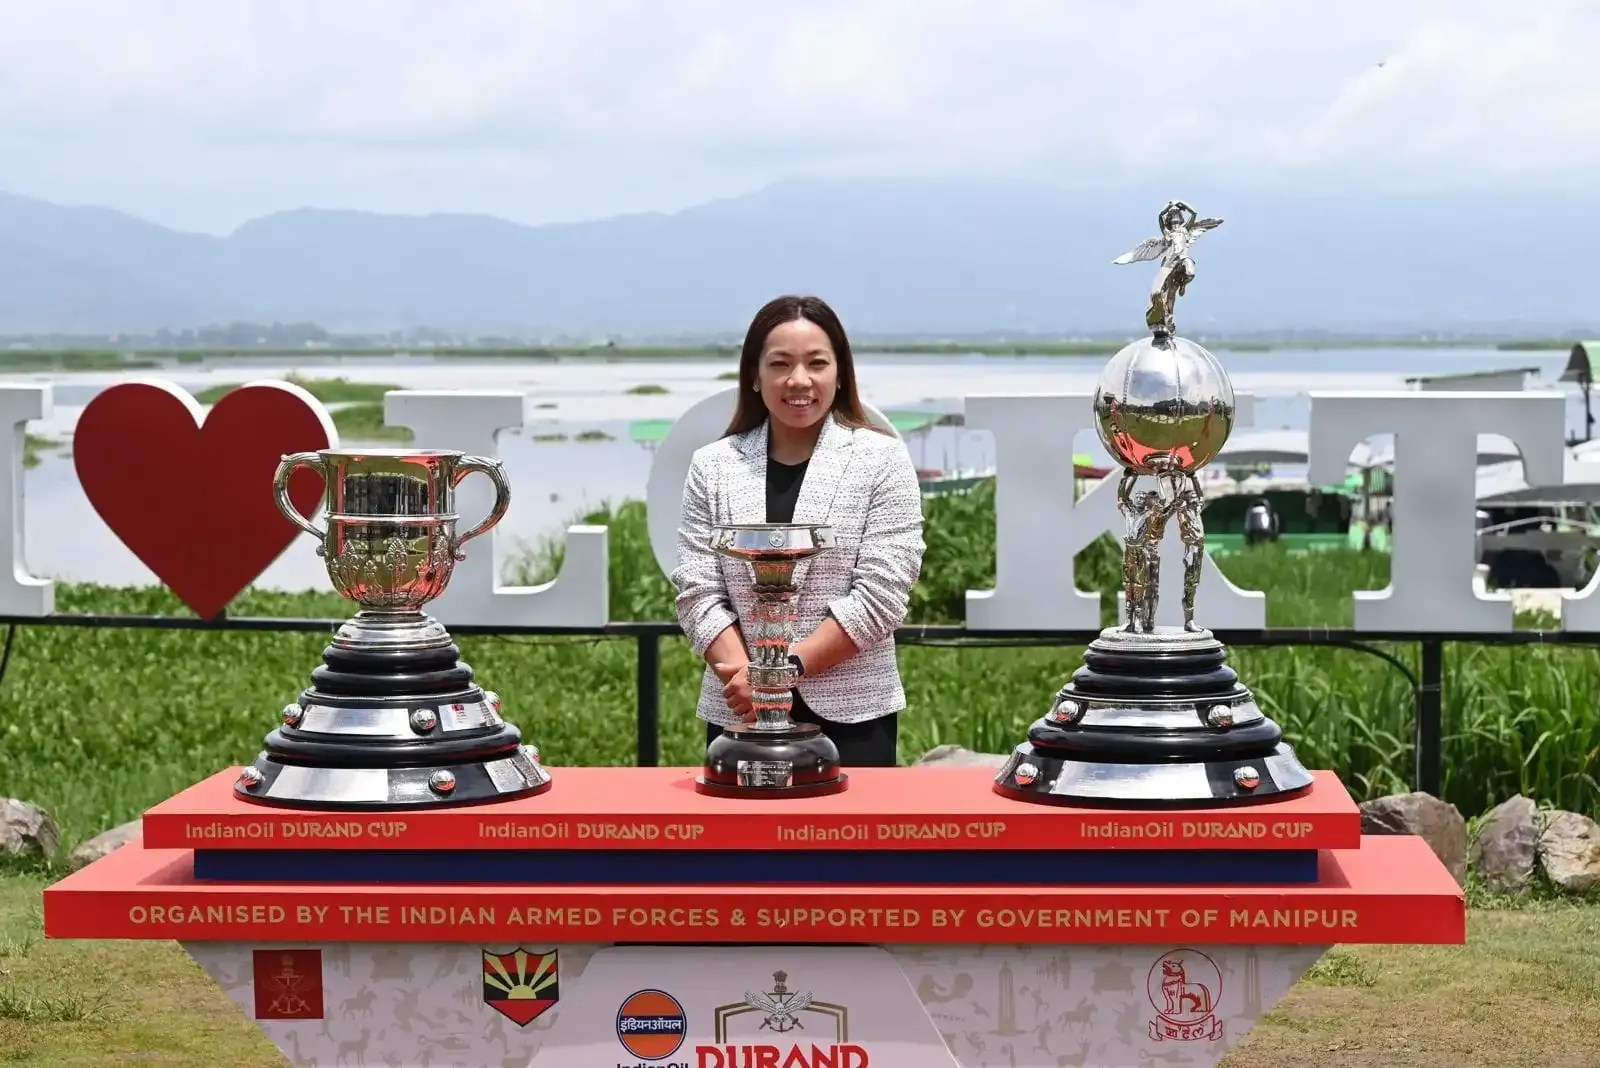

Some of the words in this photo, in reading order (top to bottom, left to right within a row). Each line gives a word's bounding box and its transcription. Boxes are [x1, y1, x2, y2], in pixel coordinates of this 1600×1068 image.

[185, 823, 273, 838] IndianOil
[281, 823, 363, 838] DURAND
[368, 823, 407, 838] CUP
[478, 823, 569, 839] IndianOil
[577, 823, 660, 839] DURAND
[665, 823, 704, 839] CUP
[777, 823, 869, 840] IndianOil
[877, 823, 961, 840] DURAND
[966, 823, 1006, 840] CUP
[1080, 822, 1174, 838] IndianOil
[1182, 822, 1267, 838] DURAND
[1272, 822, 1313, 838] CUP
[129, 905, 285, 924] ORGANISED
[298, 906, 328, 925] BY
[340, 906, 389, 925] THE
[401, 906, 495, 925] INDIAN
[507, 907, 601, 926] ARMED
[613, 907, 719, 926] FORCES
[730, 907, 746, 926] &
[758, 908, 920, 927] SUPPORTED
[932, 908, 964, 927] BY
[976, 909, 1170, 928] GOVERNMENT
[1181, 910, 1218, 929] OF
[1230, 910, 1359, 929] MANIPUR
[620, 1017, 682, 1031] इंडियनऑयल
[696, 1044, 869, 1068] DURAND
